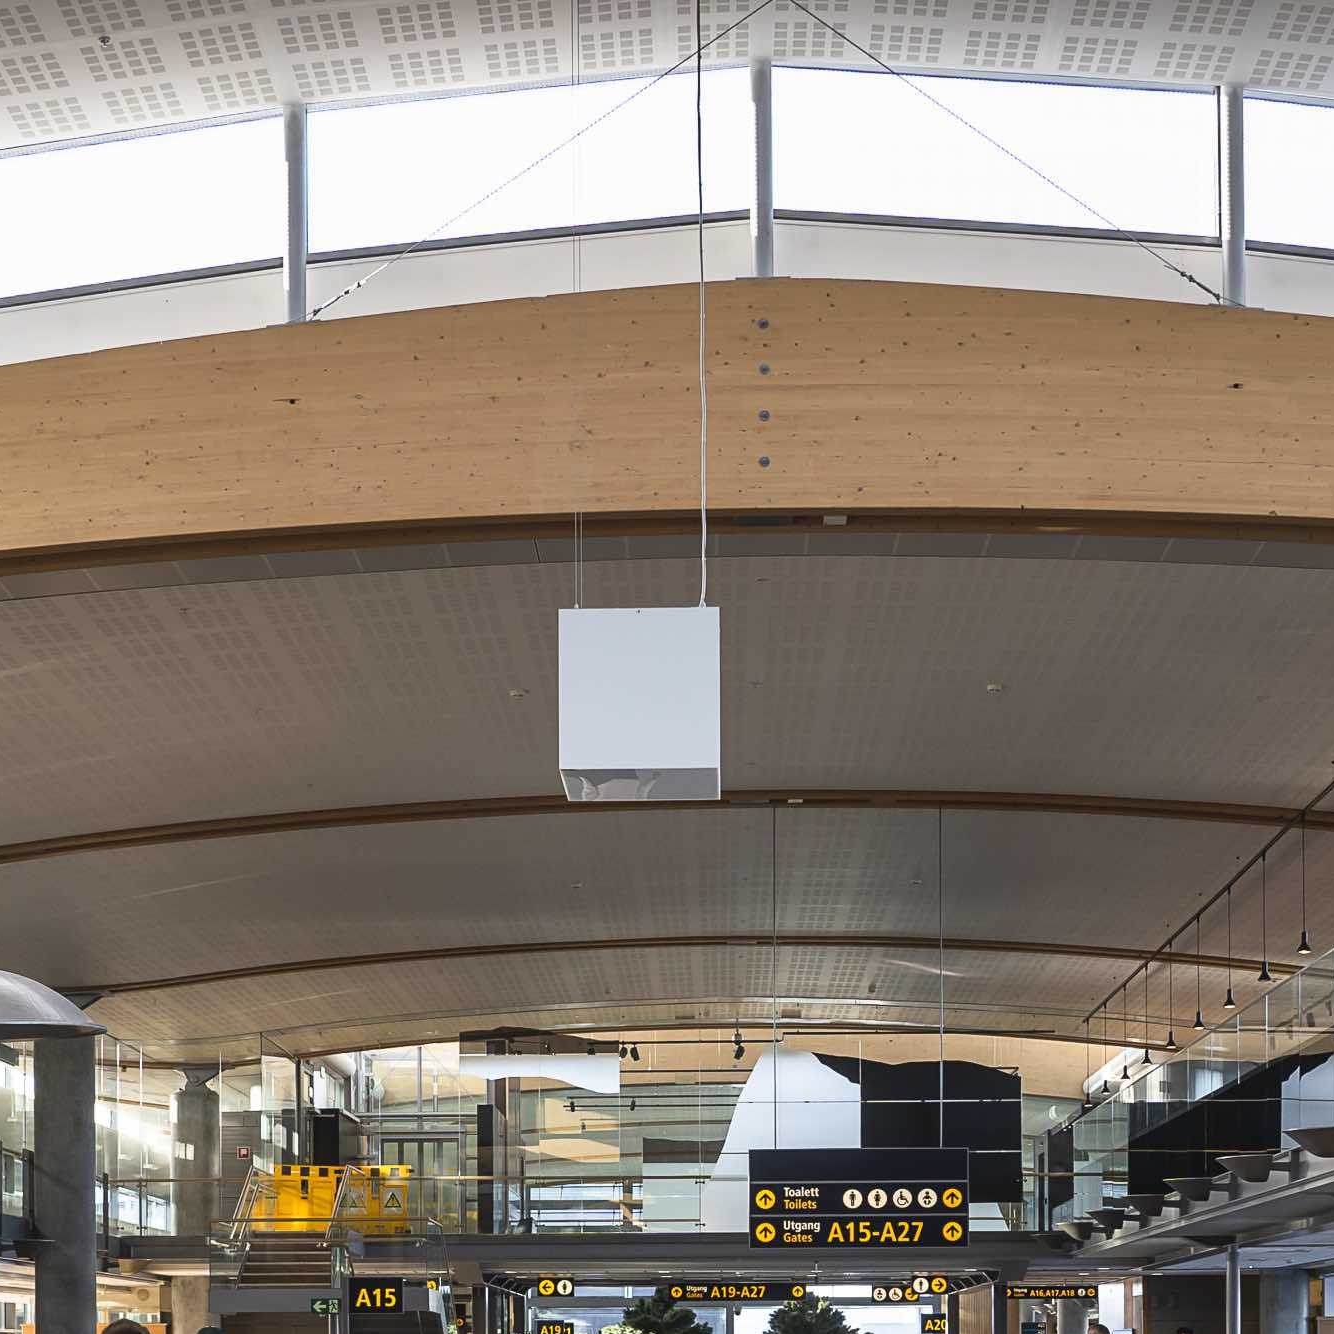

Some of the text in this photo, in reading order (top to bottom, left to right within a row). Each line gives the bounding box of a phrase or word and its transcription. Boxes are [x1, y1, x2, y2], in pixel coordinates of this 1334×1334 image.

[783, 1187, 820, 1197] Toalett
[783, 1199, 817, 1210] Toilets
[783, 1220, 820, 1233] Utgang
[827, 1221, 924, 1243] A15-A27
[783, 1232, 813, 1243] Gates
[355, 1288, 397, 1308] A15
[710, 1286, 766, 1298] A19-A27
